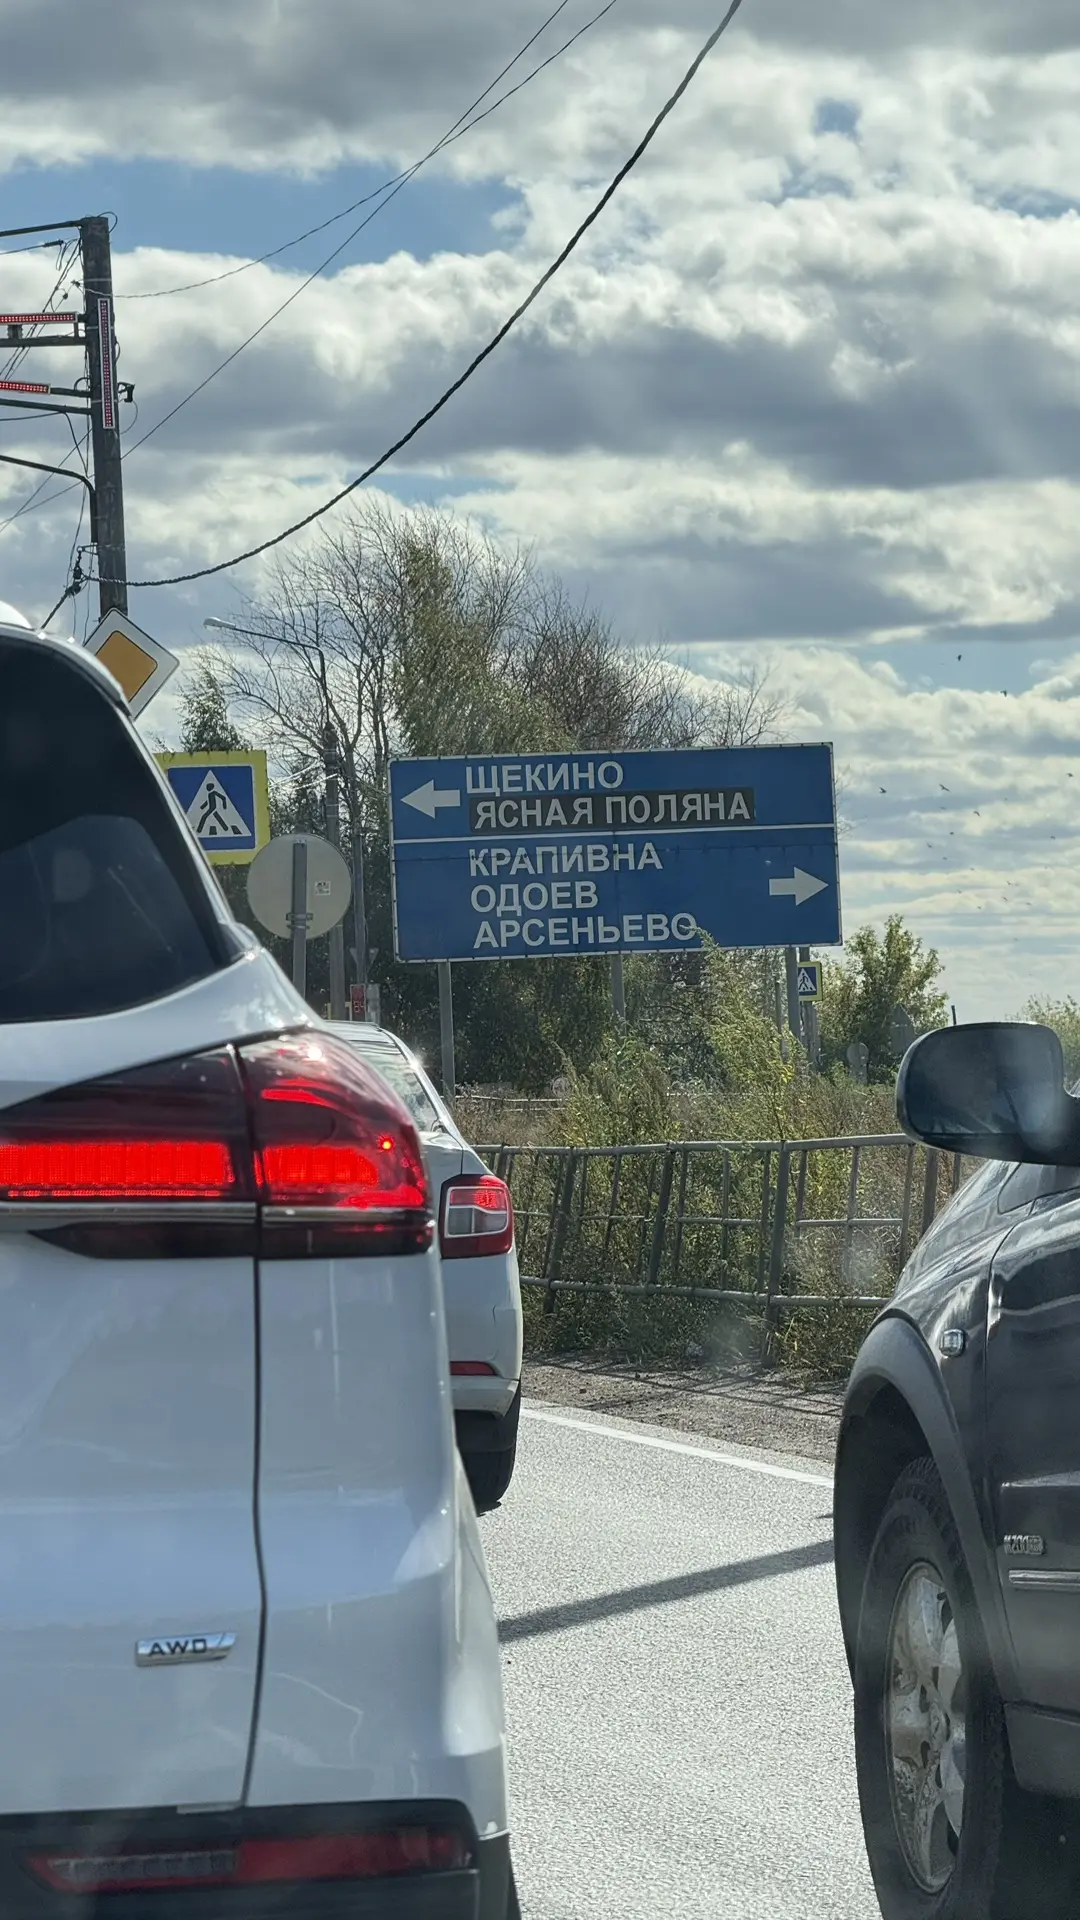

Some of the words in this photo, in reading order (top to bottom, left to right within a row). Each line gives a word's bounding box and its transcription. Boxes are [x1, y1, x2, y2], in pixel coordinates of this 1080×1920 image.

[465, 761, 624, 796] ЩЕКИНО
[474, 797, 594, 830] ЯСНАЯ
[605, 791, 750, 824] ПОЛЯНА
[469, 842, 663, 877] КРАПИВНА
[470, 880, 599, 917] ОДОЕВ
[473, 912, 698, 949] АРСЕНЬЕВО
[149, 1638, 207, 1656] AWD
